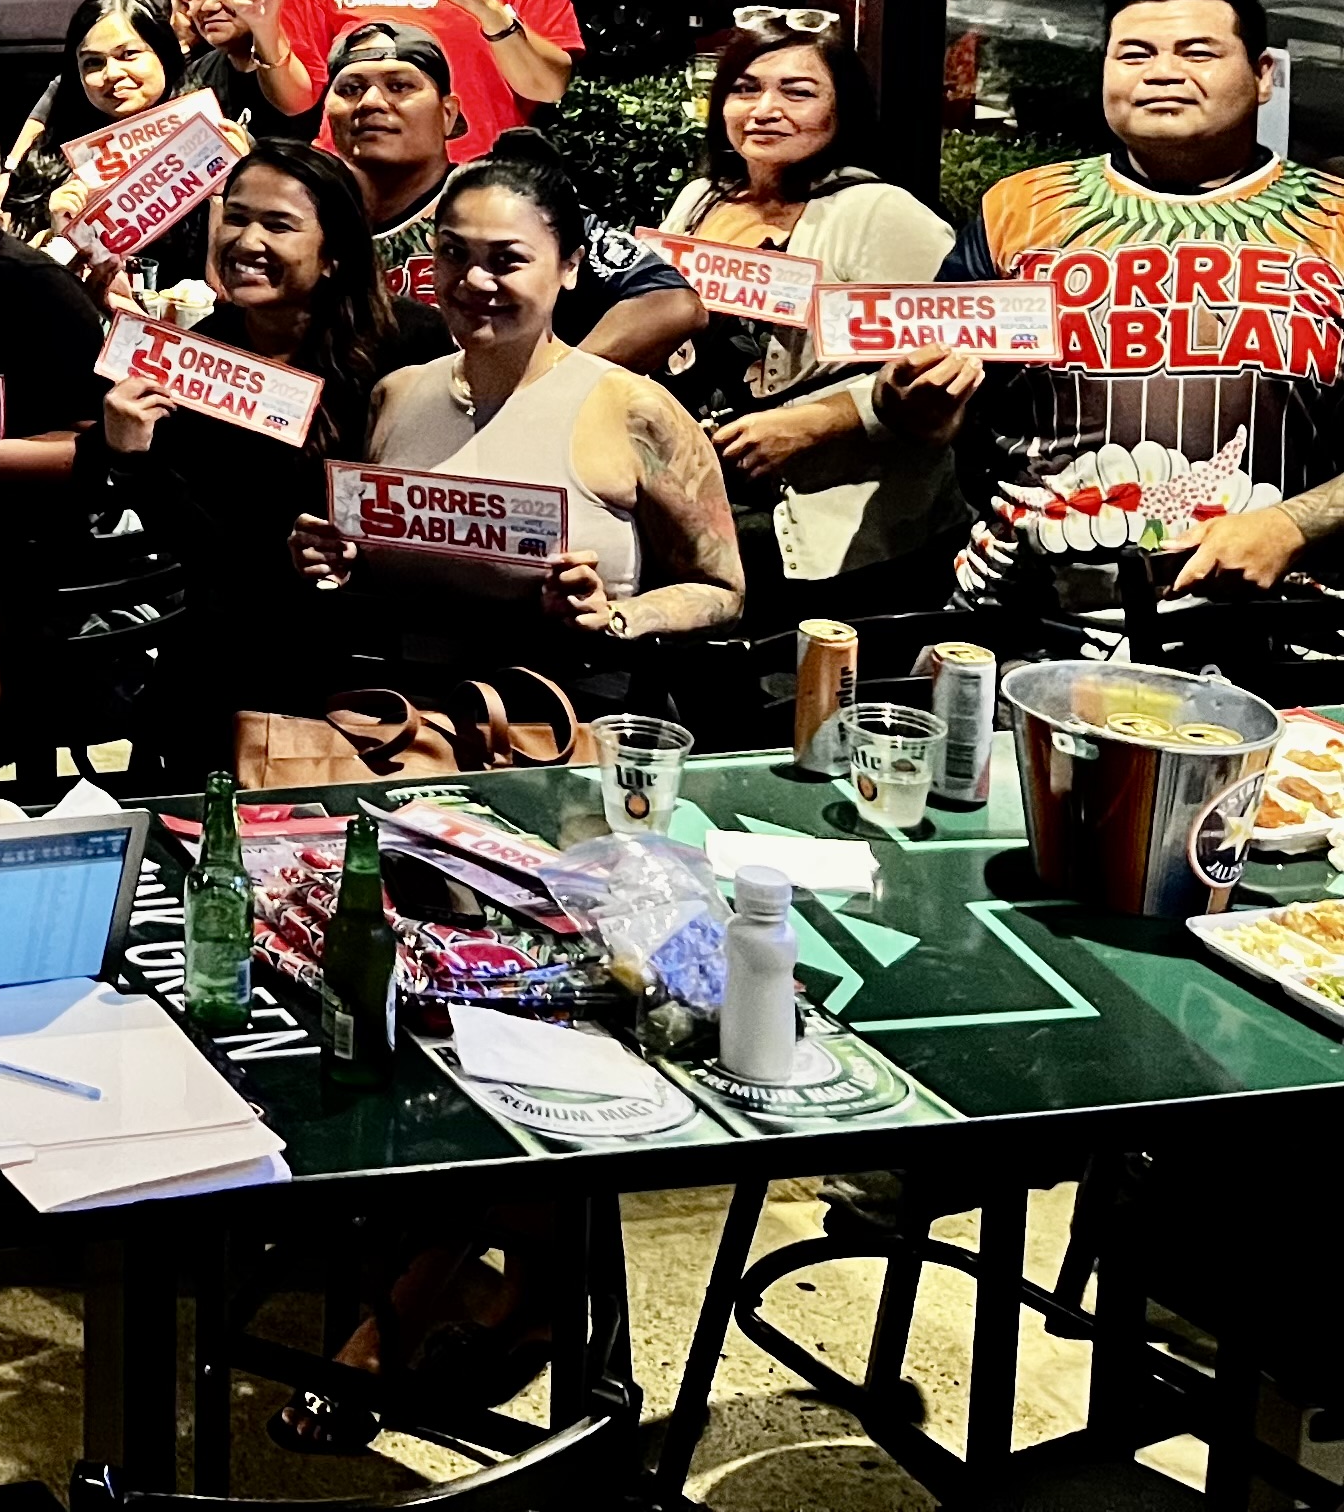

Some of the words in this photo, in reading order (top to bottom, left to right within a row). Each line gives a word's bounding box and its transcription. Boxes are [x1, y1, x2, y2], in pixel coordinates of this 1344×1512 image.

[84, 153, 185, 232] TORRES
[99, 170, 205, 254] SABLAN
[662, 240, 773, 285] TORRES
[693, 278, 769, 311] ABLAN
[847, 291, 997, 324] TORRES
[999, 298, 1047, 313] 2022
[848, 316, 997, 351] SABLAN
[1051, 307, 1344, 386] ABLAN
[142, 324, 266, 395] TORRES
[360, 472, 507, 519] TORRES
[510, 498, 558, 518] 2022
[359, 498, 507, 552] SABLAN
[488, 1088, 594, 1124] PREMIUM
[689, 1067, 809, 1105] PREMIUM
